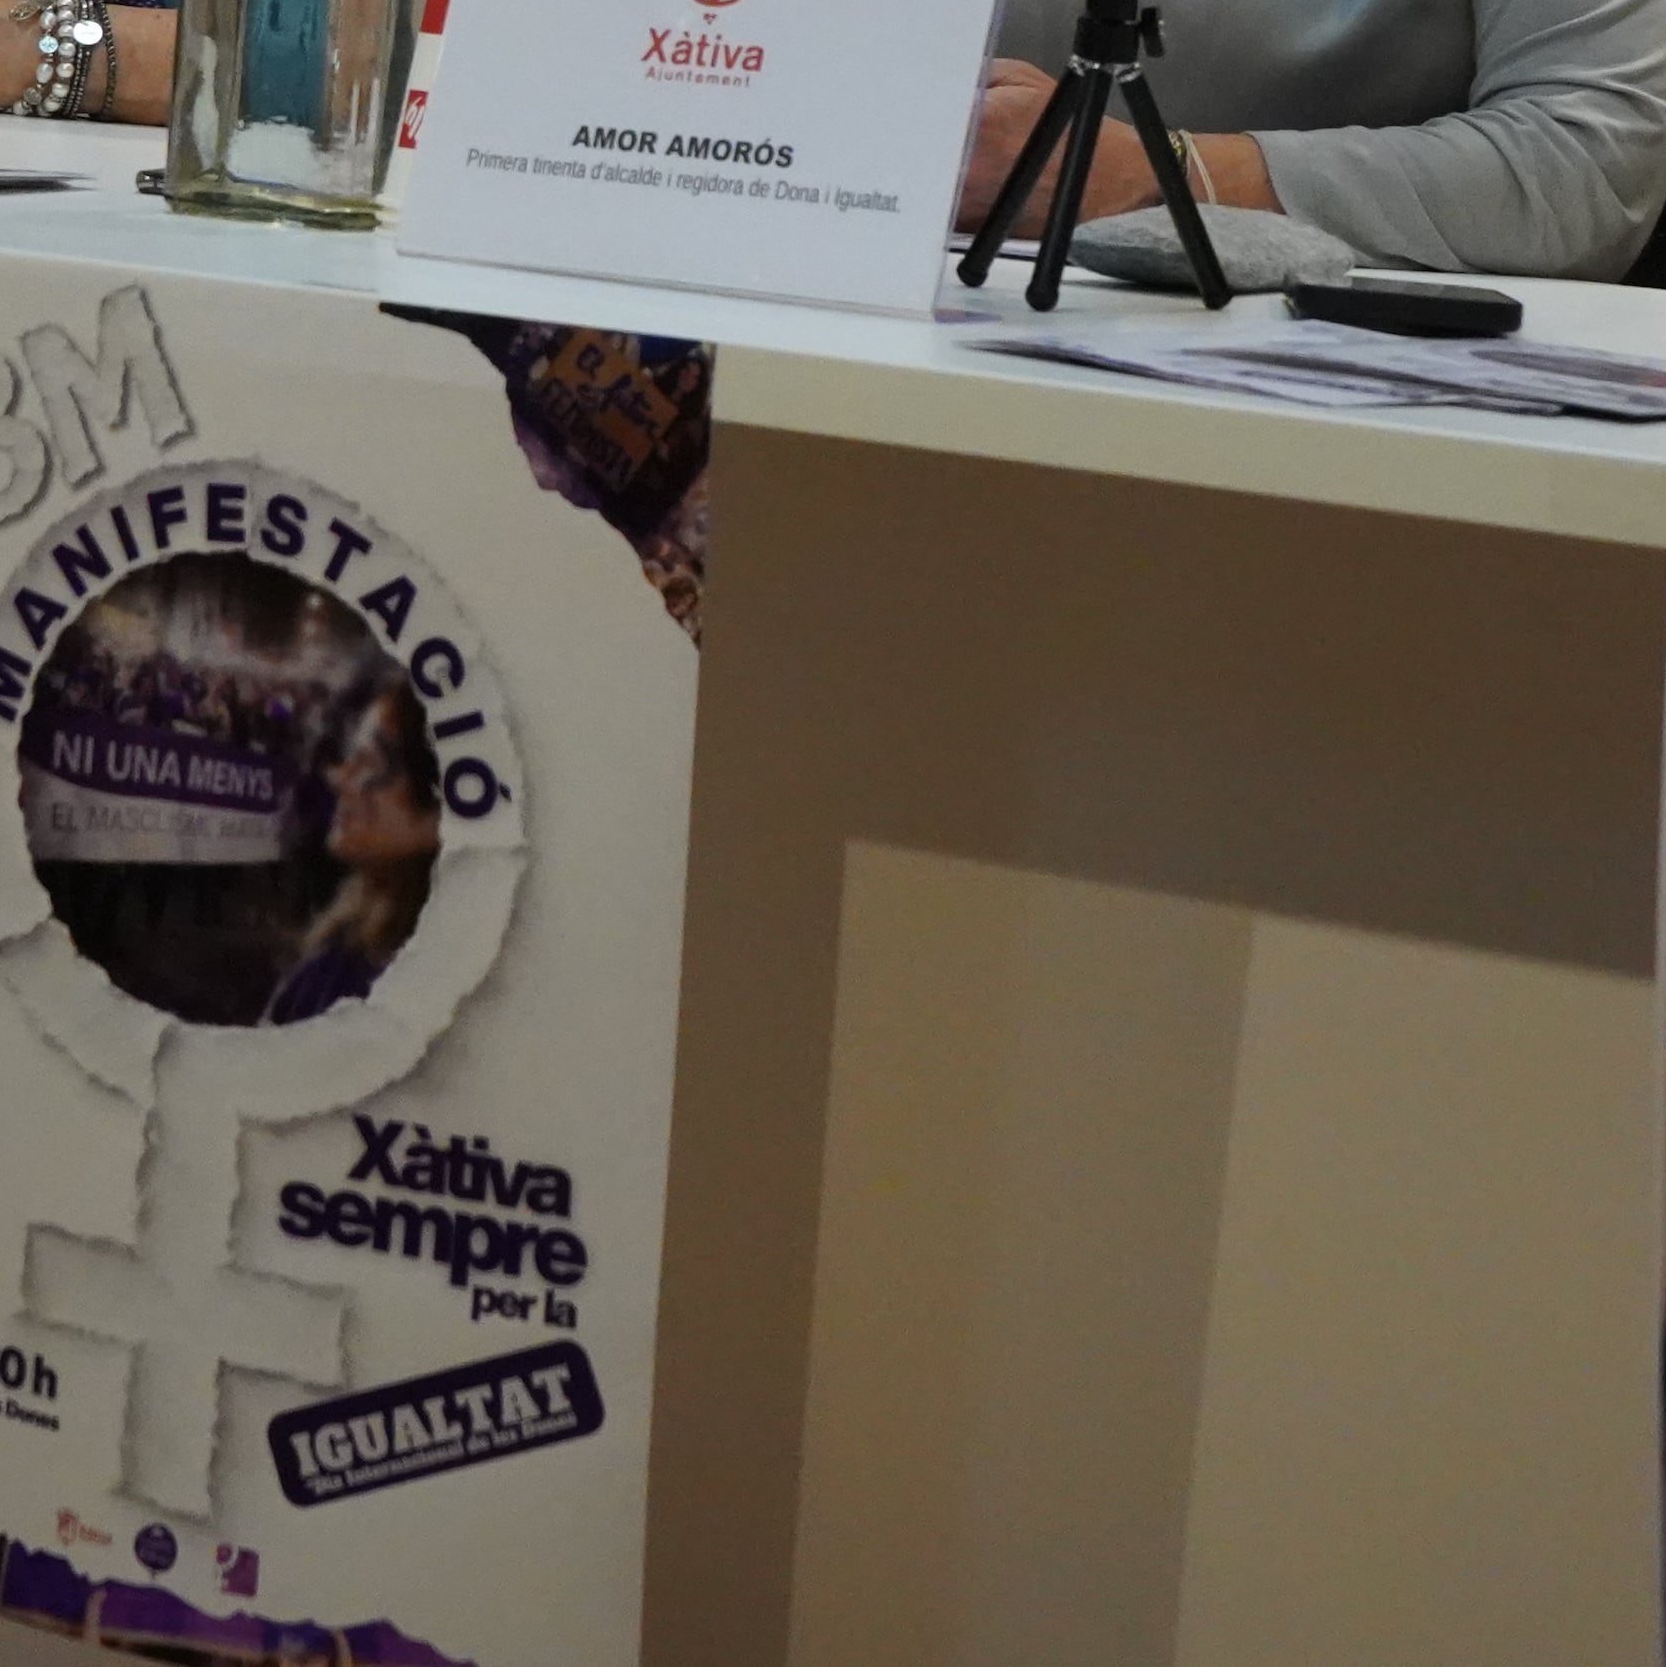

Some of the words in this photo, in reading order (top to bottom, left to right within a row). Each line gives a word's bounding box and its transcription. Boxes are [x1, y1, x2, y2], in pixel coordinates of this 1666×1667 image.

[641, 27, 766, 73] Xàtiva
[645, 65, 752, 89] Ajuntament
[572, 124, 659, 155] AMOR
[665, 128, 796, 169] AMORÓS
[467, 148, 528, 175] Primera
[532, 154, 587, 179] tinenta
[591, 160, 663, 188] d'alcalde
[676, 170, 744, 200] regidora
[748, 177, 770, 198] de
[774, 180, 820, 205] Dona
[52, 730, 95, 775] NI
[106, 740, 181, 787] UNA
[187, 755, 274, 802] MENYS
[348, 1114, 572, 1218] Xàtiva
[279, 1181, 588, 1288] sempre
[471, 1286, 537, 1321] per
[543, 1288, 577, 1329] la
[33, 1354, 59, 1402] h
[5, 1399, 60, 1432] Dones
[289, 1363, 572, 1477] IGUALTAT
